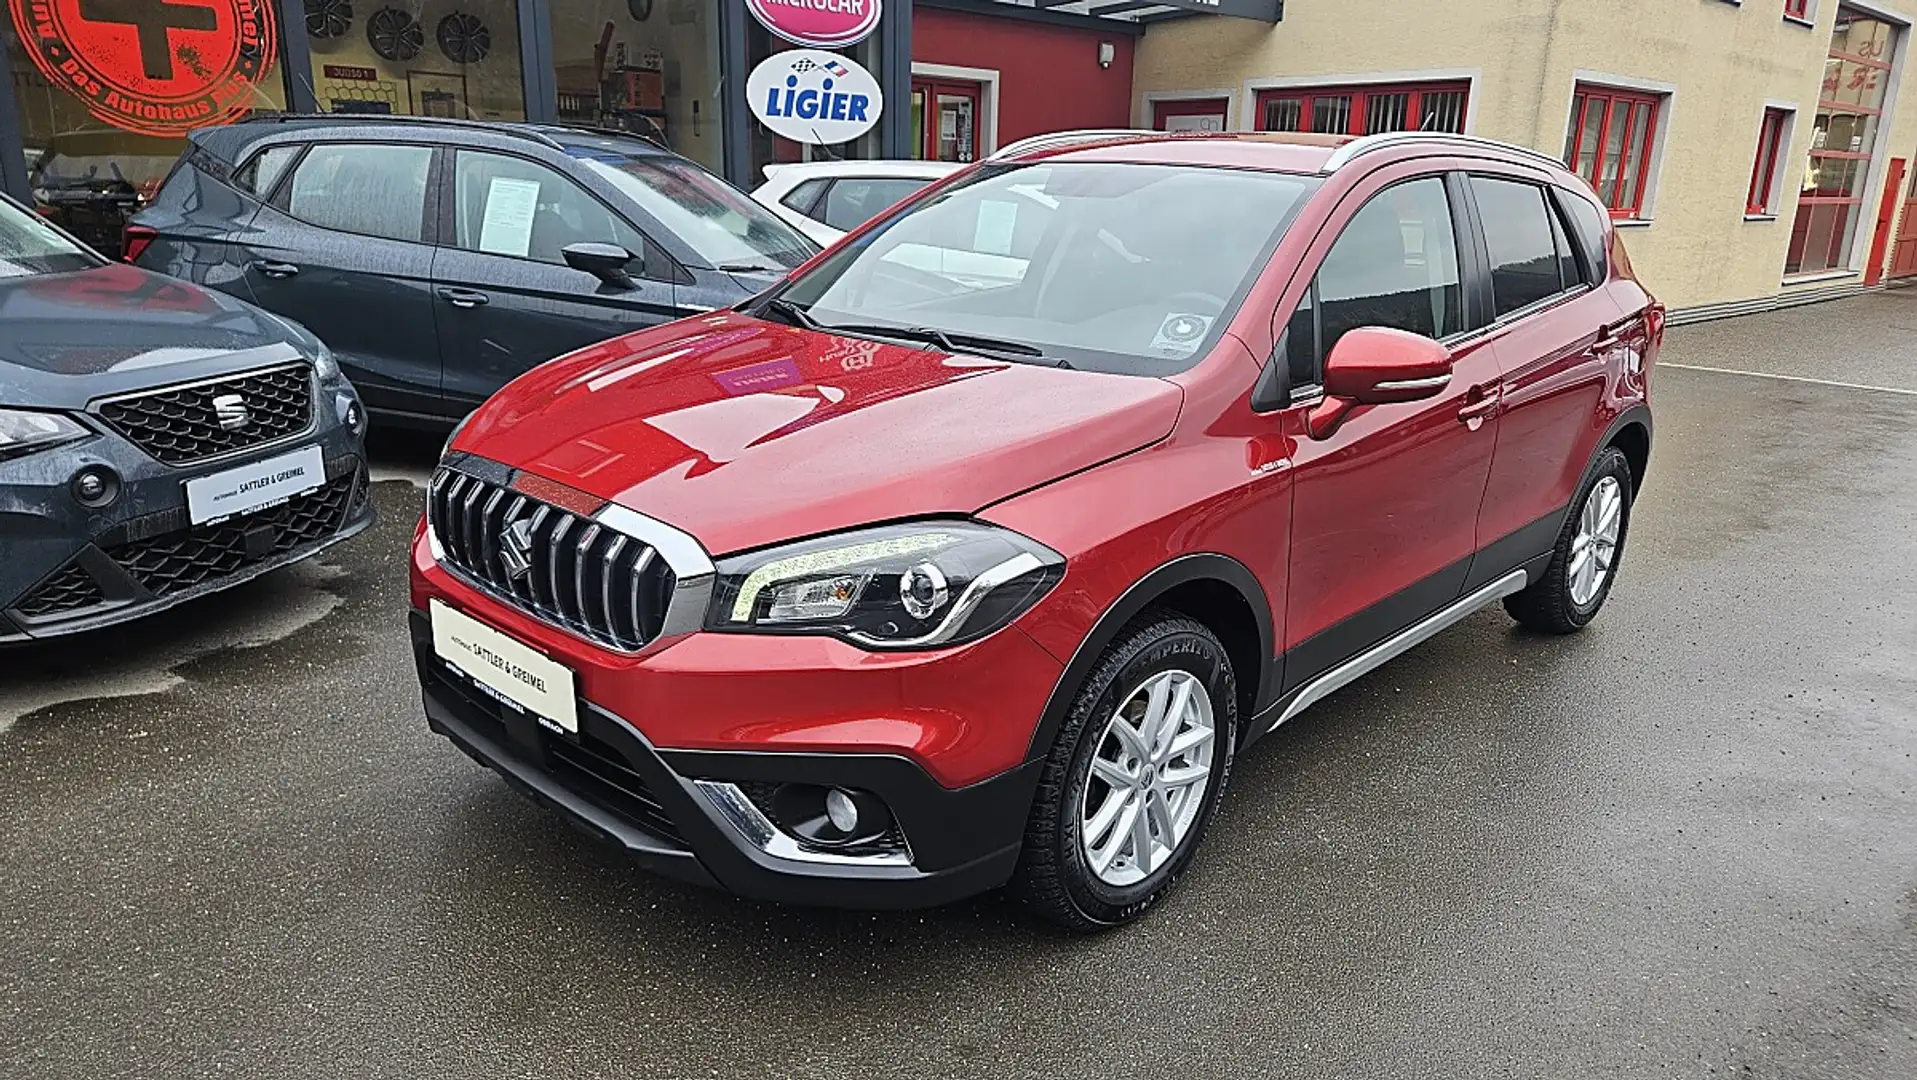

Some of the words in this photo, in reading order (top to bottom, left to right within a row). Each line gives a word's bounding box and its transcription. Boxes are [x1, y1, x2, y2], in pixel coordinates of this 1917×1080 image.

[31, 0, 56, 40] Au
[767, 0, 864, 16] ROCAR
[60, 58, 101, 97] Das
[105, 90, 211, 121] Autohaus
[210, 70, 250, 108] Plus
[766, 75, 869, 122] LIGIER
[239, 478, 270, 494] SATTLER
[271, 474, 276, 484] &
[276, 467, 305, 482] GREIMEL
[473, 643, 504, 670] SATTLER
[505, 661, 511, 674] &
[512, 665, 547, 694] GREIMEL
